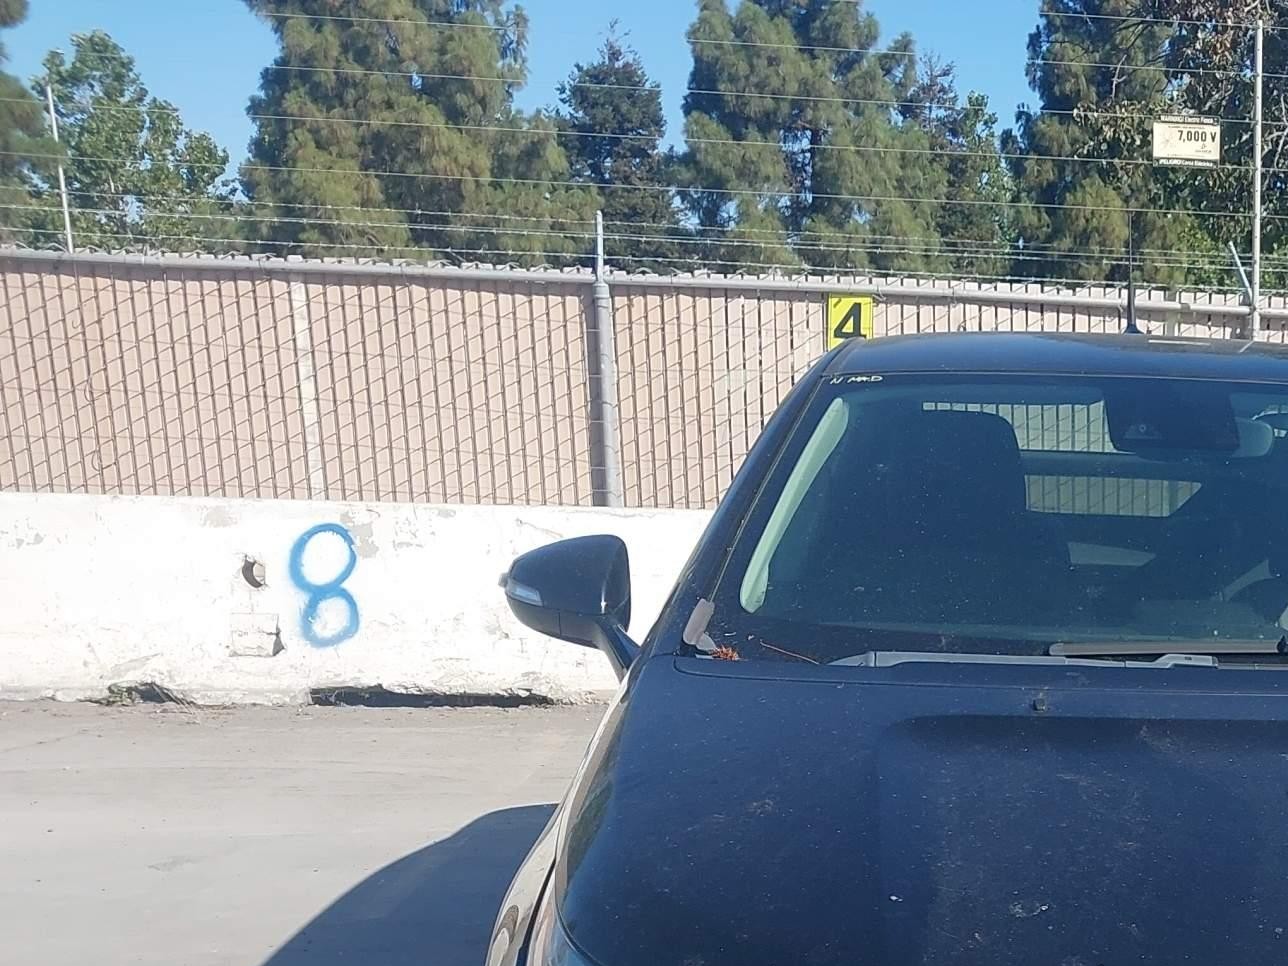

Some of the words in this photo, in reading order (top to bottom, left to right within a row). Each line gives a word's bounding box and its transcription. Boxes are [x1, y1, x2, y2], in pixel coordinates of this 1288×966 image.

[1178, 130, 1207, 143] 7,000
[1210, 131, 1217, 143] V
[833, 302, 867, 339] 4
[289, 522, 359, 648] 8
